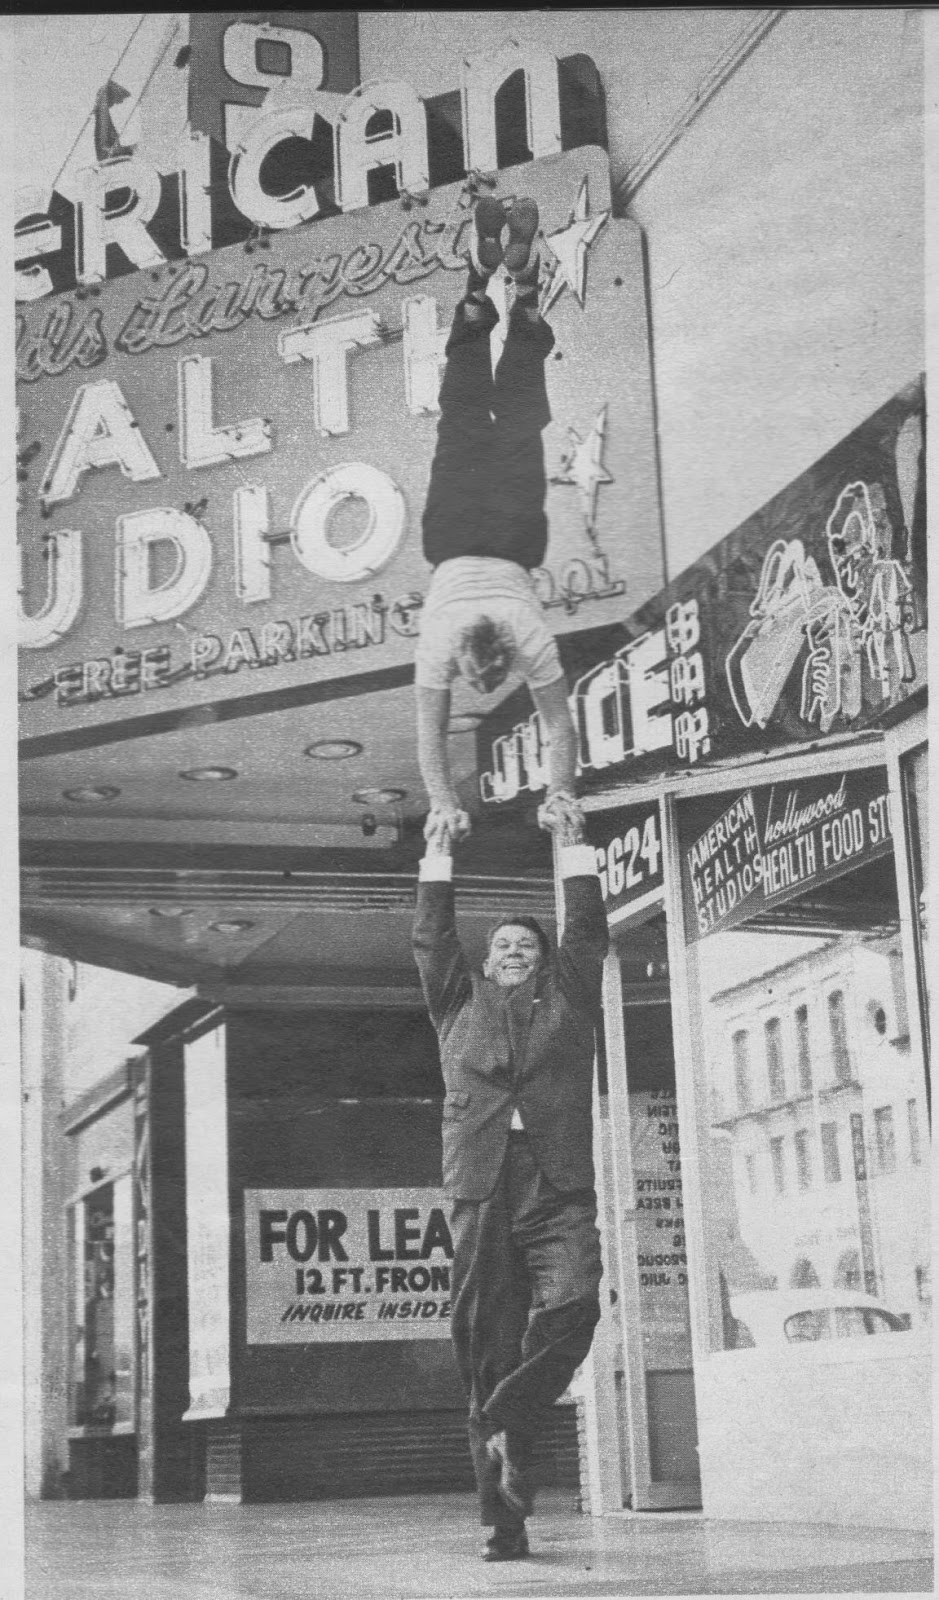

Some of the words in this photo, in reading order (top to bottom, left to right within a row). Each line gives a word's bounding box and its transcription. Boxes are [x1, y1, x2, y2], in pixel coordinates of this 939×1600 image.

[17, 462, 406, 650] UDIO
[54, 646, 172, 706] FREE
[188, 591, 423, 681] PARKING
[480, 628, 673, 803] JUCE
[689, 793, 754, 872] AMERICAN
[694, 826, 758, 904] HEALTH
[763, 831, 816, 896] HEALTH
[822, 808, 864, 867] FOOD
[698, 853, 763, 934] STUDIOS
[259, 1208, 349, 1263] FOR
[367, 1207, 454, 1262] LEA
[281, 1302, 367, 1323] INQUIRE
[377, 1301, 451, 1319] INSIDE
[296, 1267, 326, 1296] 12
